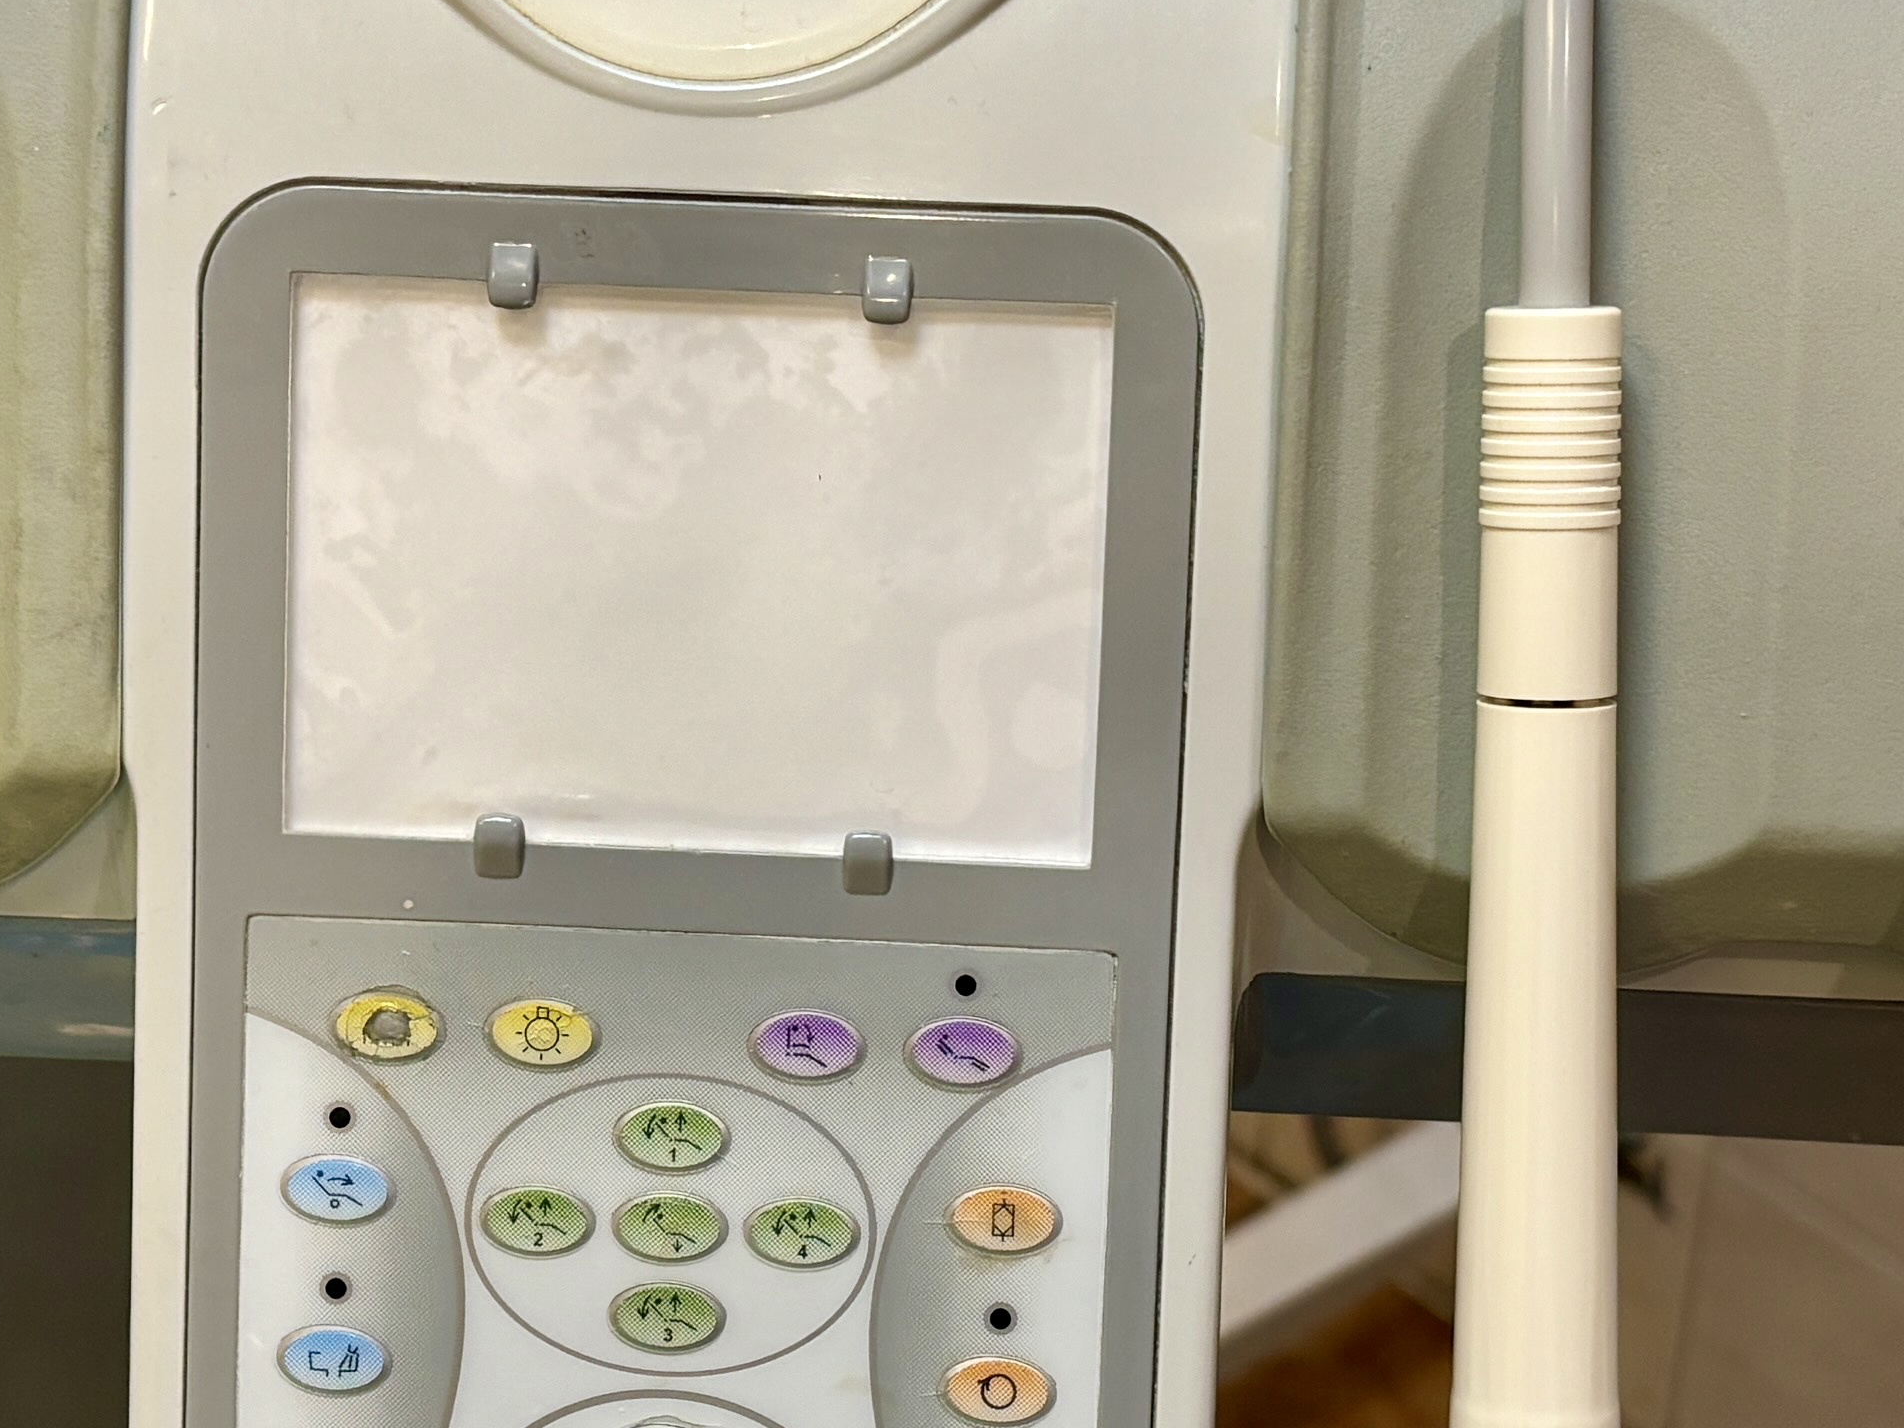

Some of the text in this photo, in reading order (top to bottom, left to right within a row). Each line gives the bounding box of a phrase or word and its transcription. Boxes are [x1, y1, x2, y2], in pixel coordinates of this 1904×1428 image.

[668, 1147, 678, 1162] 1
[533, 1231, 544, 1247] 2
[797, 1244, 808, 1259] 4
[663, 1328, 673, 1342] 3
